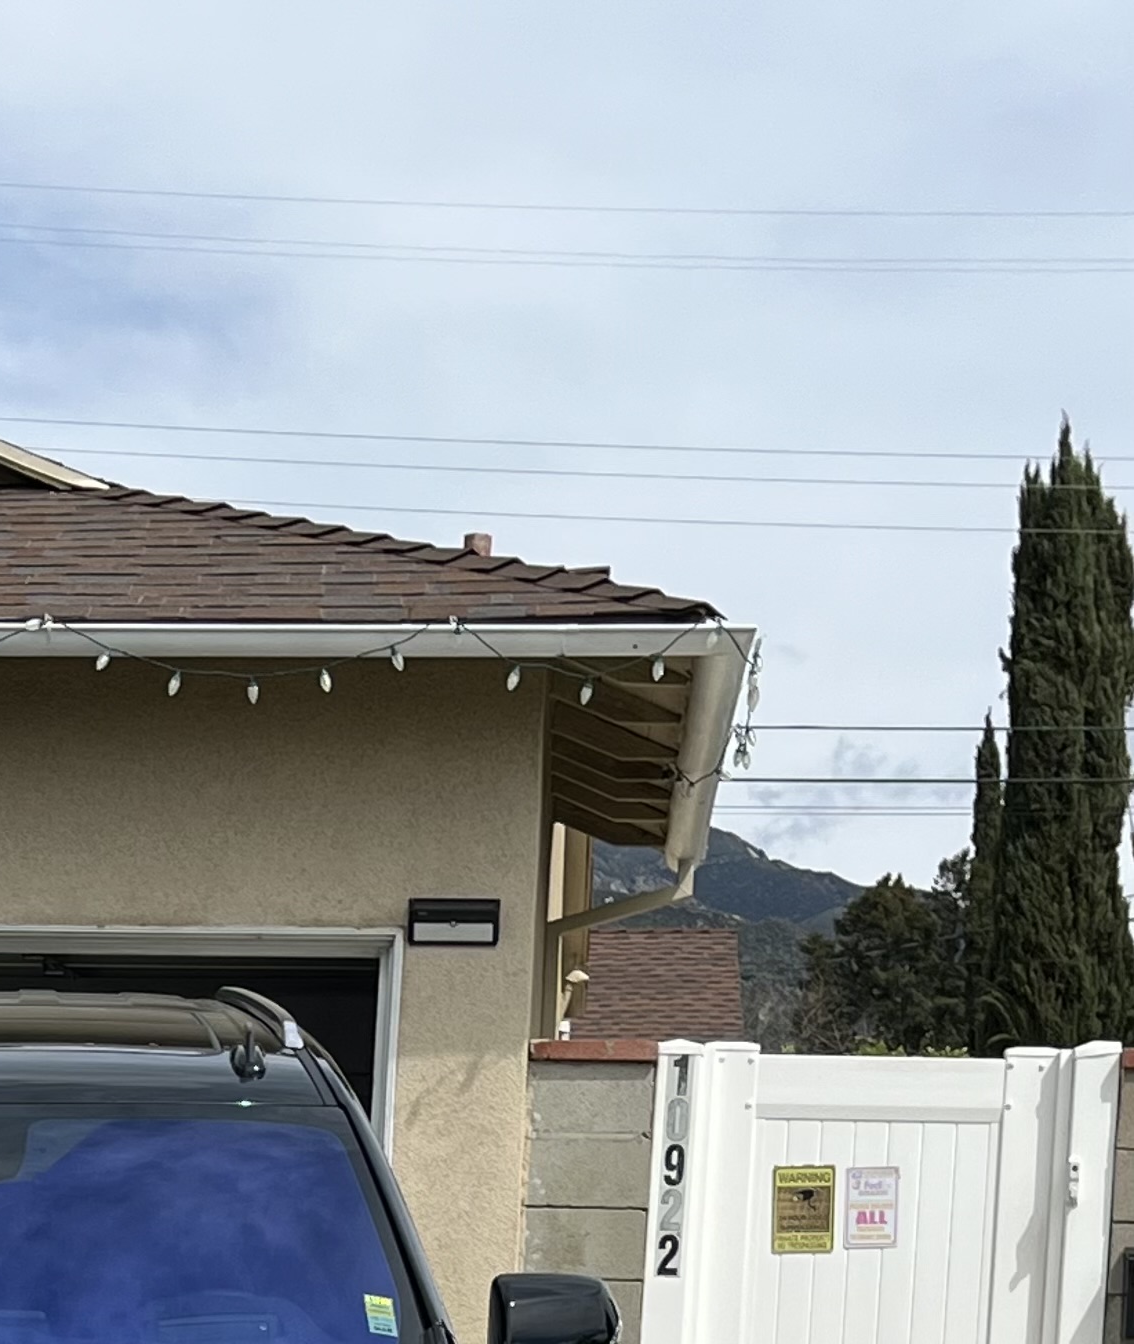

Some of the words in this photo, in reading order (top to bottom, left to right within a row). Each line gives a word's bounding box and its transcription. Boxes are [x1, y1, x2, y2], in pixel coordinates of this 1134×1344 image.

[657, 1054, 689, 1275] 10922
[777, 1172, 831, 1184] WARNING
[856, 1210, 888, 1225] ALL
